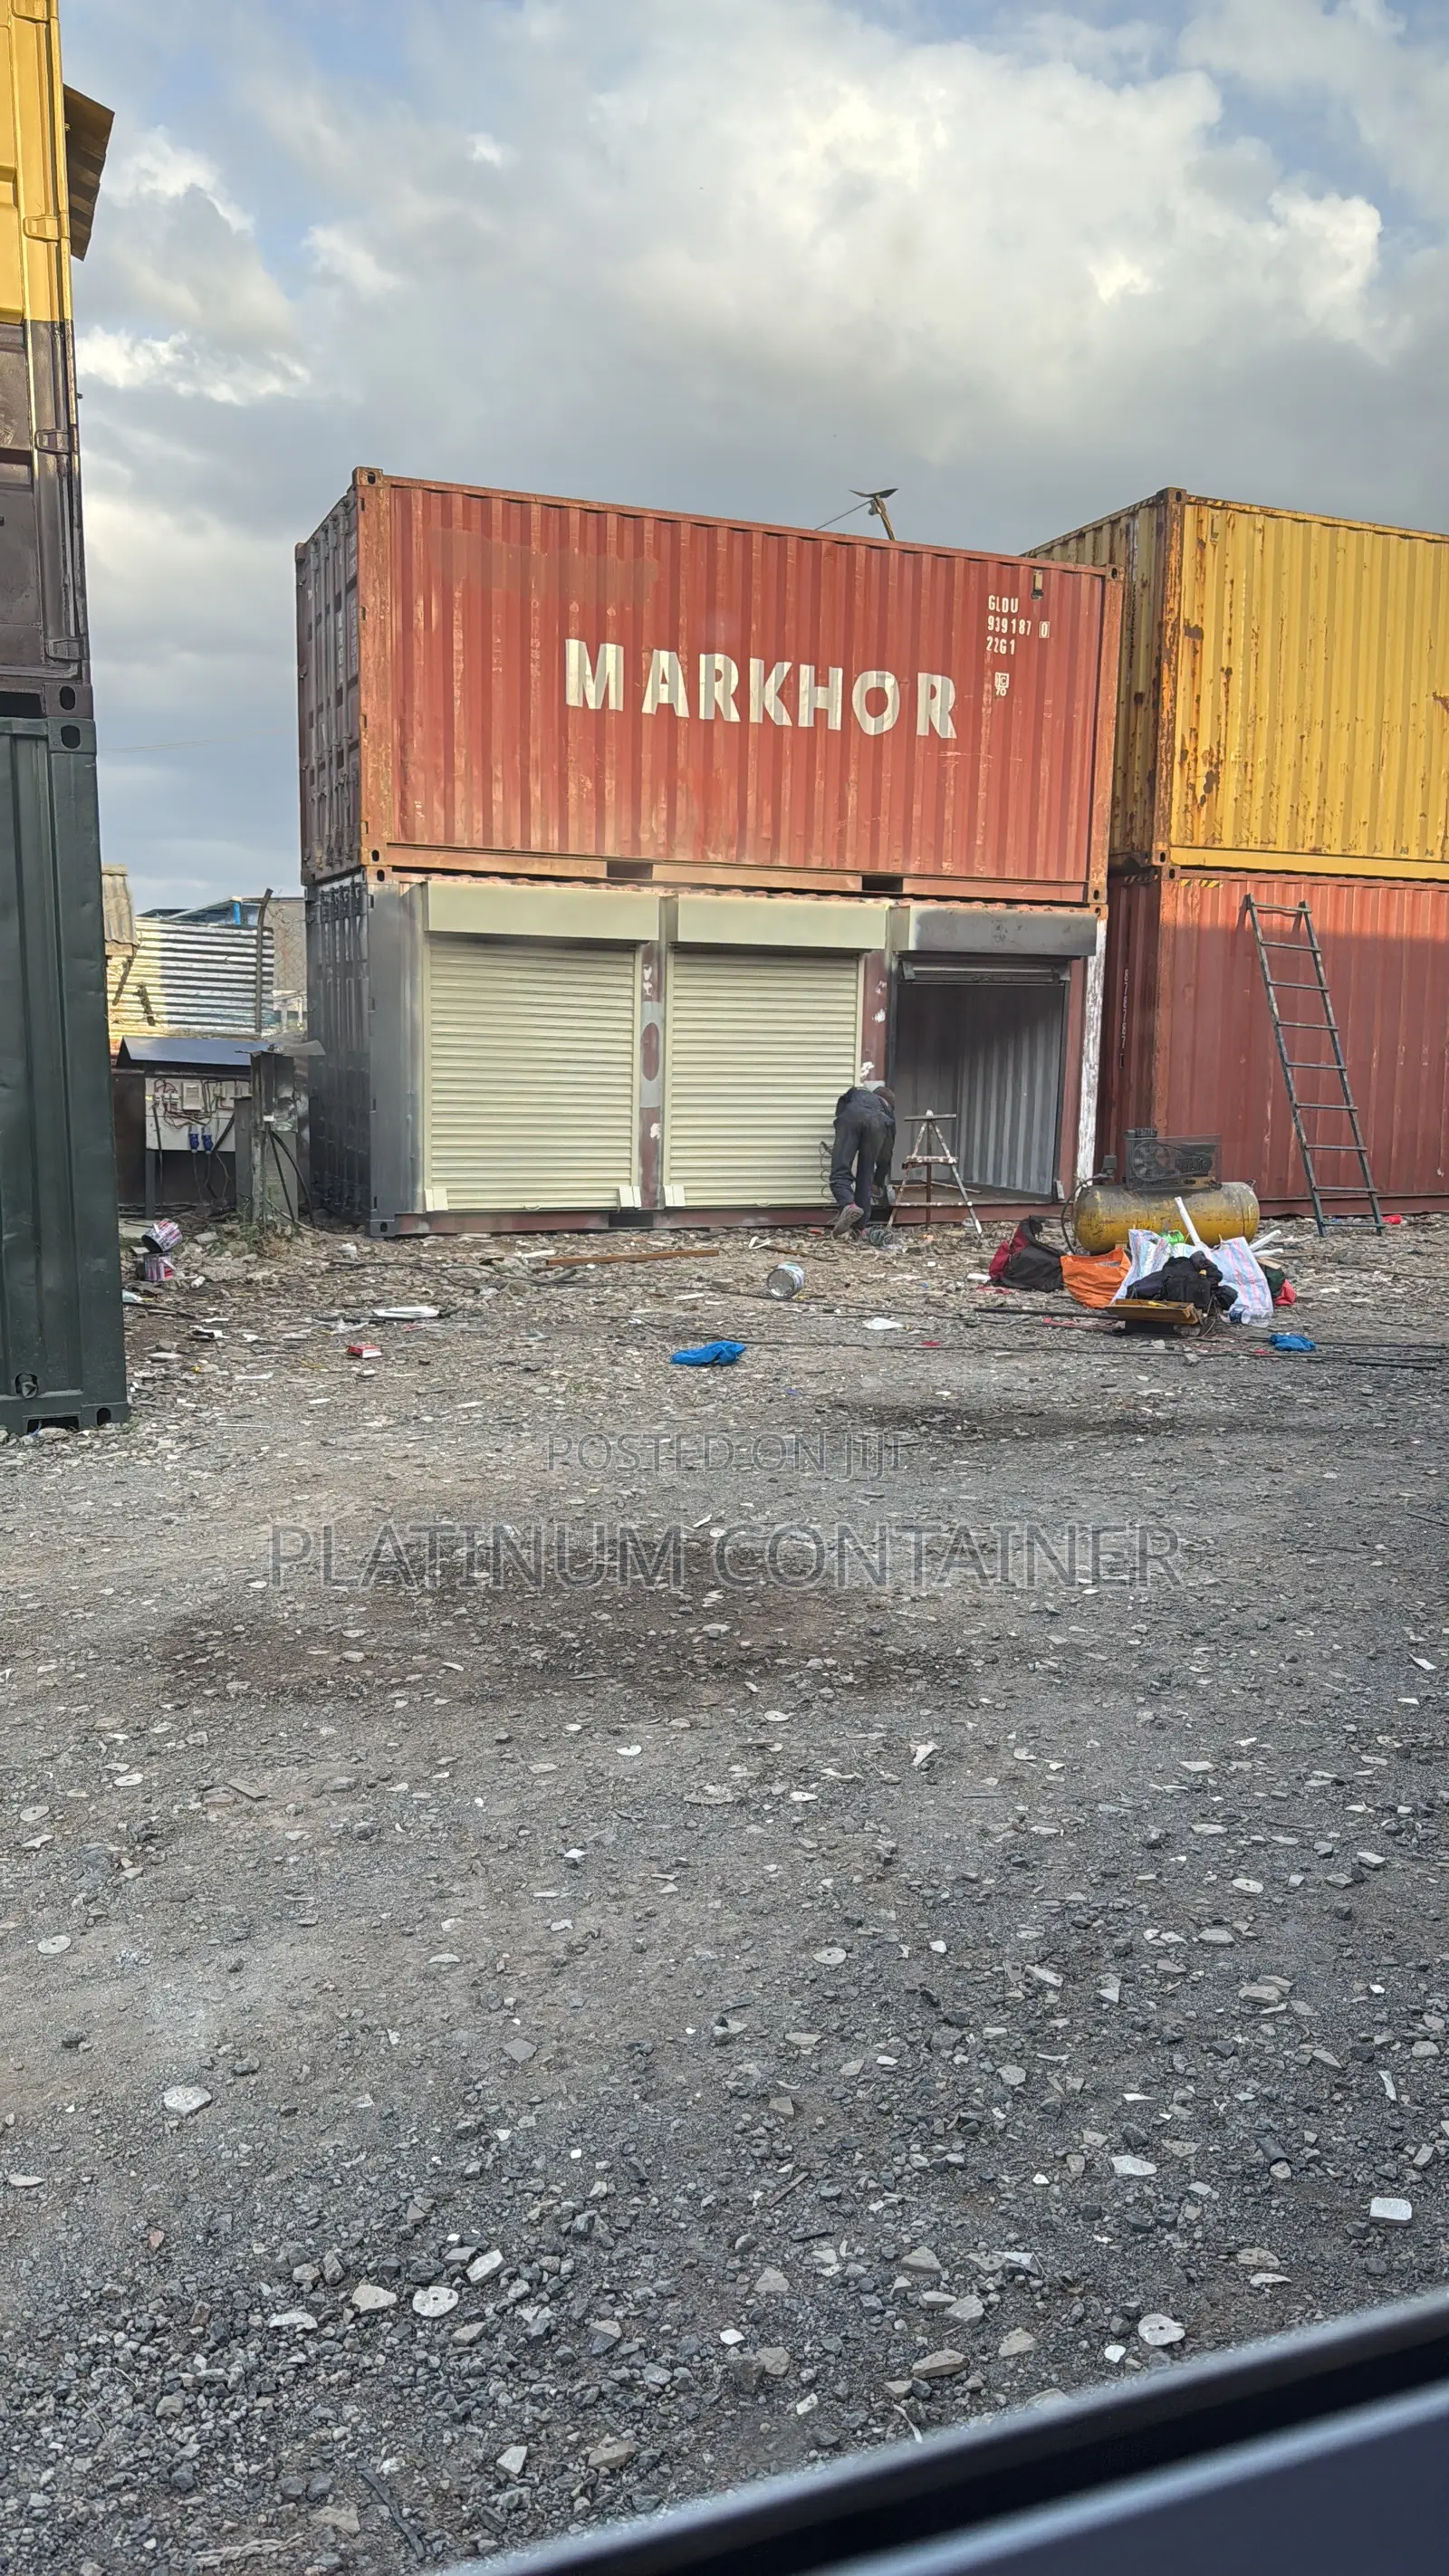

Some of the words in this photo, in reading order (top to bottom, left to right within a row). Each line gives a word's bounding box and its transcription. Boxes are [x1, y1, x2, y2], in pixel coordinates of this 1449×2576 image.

[988, 594, 1019, 614] GLDU
[987, 615, 1032, 636] 939187
[986, 636, 1015, 656] 22G1
[565, 638, 957, 739] MARKHOR
